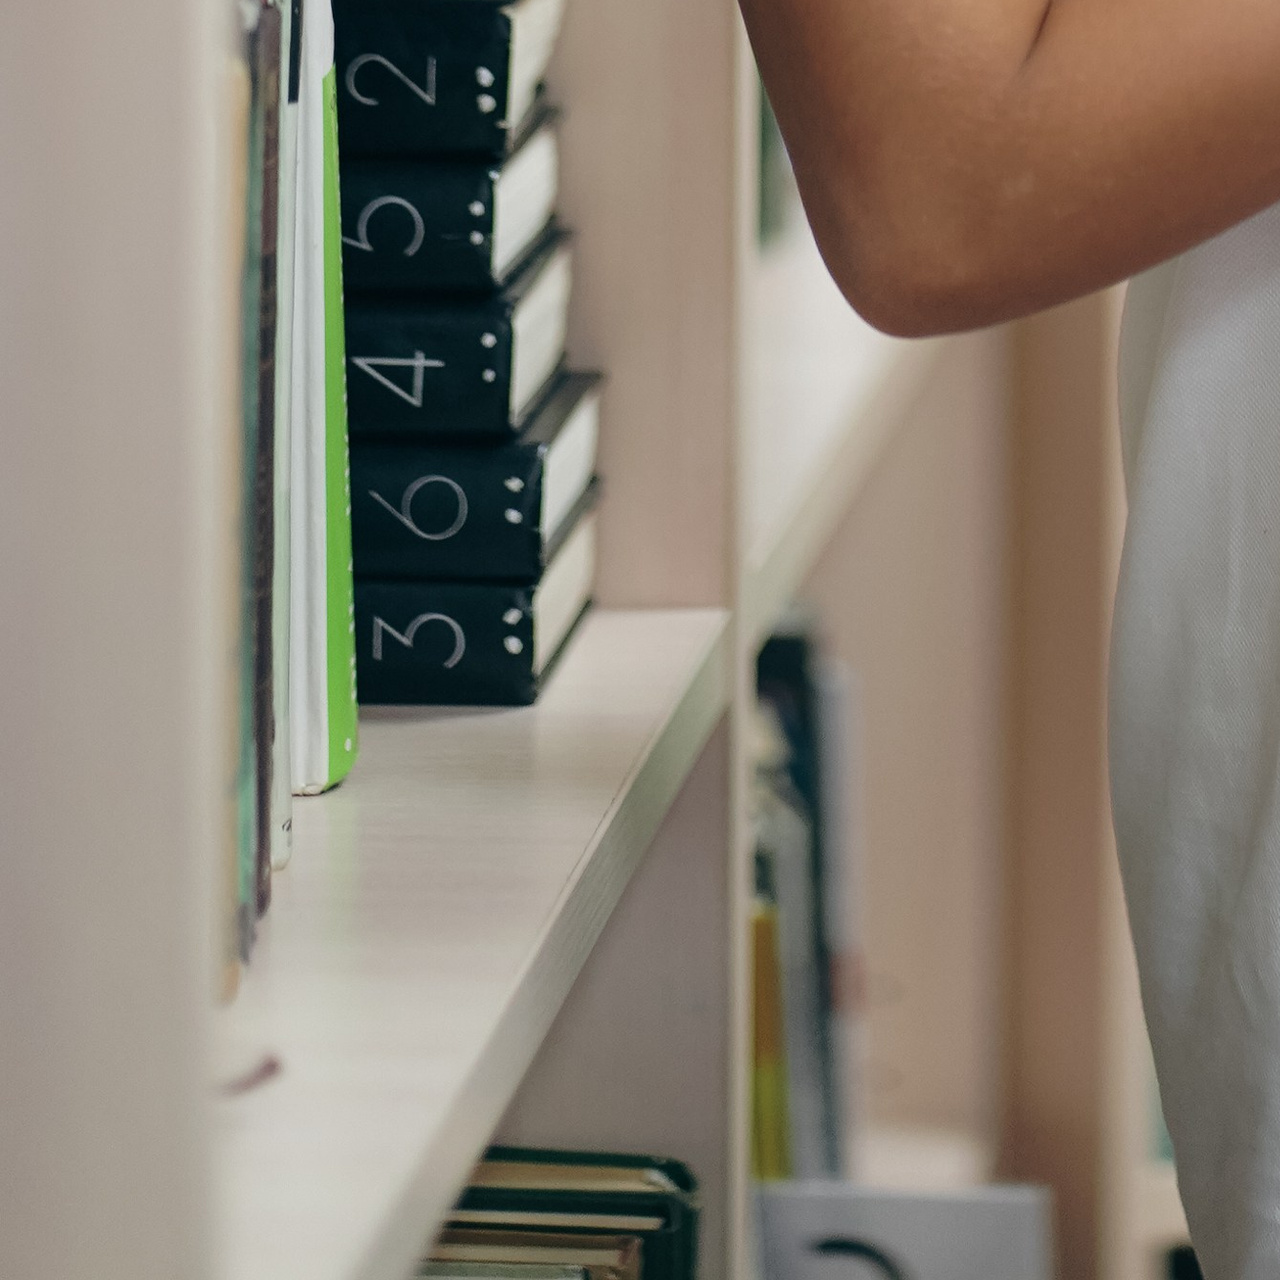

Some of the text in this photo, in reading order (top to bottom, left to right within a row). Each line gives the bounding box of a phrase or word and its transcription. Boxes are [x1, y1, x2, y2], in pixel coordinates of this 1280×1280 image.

[345, 53, 437, 106] 2
[341, 195, 426, 257] 5
[350, 350, 446, 408] 4
[368, 474, 469, 541] 6
[372, 612, 466, 669] 3
